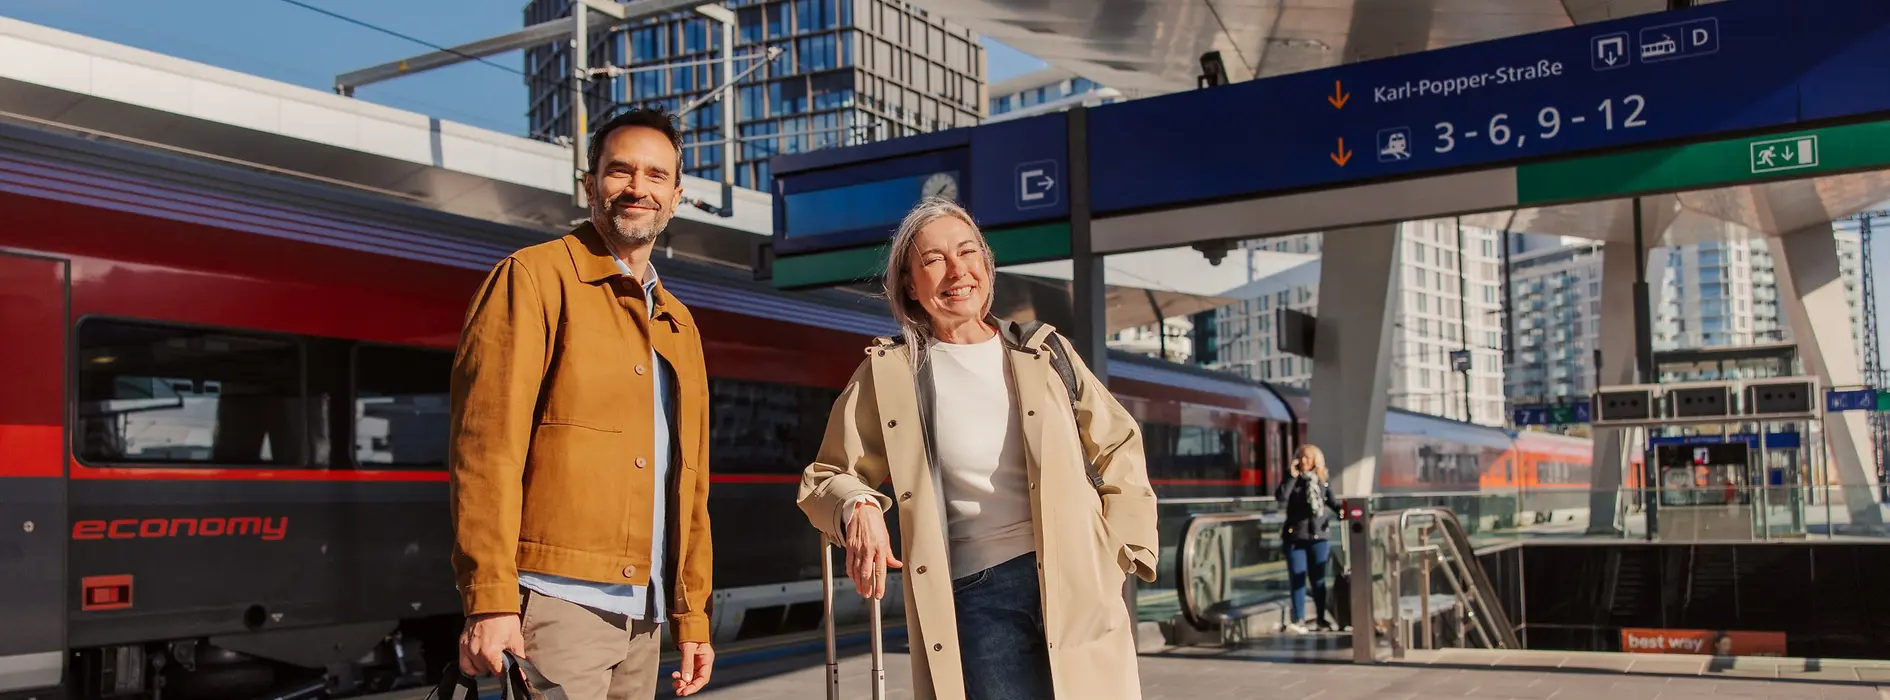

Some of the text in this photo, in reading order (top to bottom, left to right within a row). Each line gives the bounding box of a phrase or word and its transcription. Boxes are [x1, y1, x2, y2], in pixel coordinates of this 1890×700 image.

[1692, 28, 1709, 47] D
[1373, 59, 1563, 104] Karl-Popper-Straße
[72, 516, 289, 541] economy
[1627, 633, 1704, 652] best way
